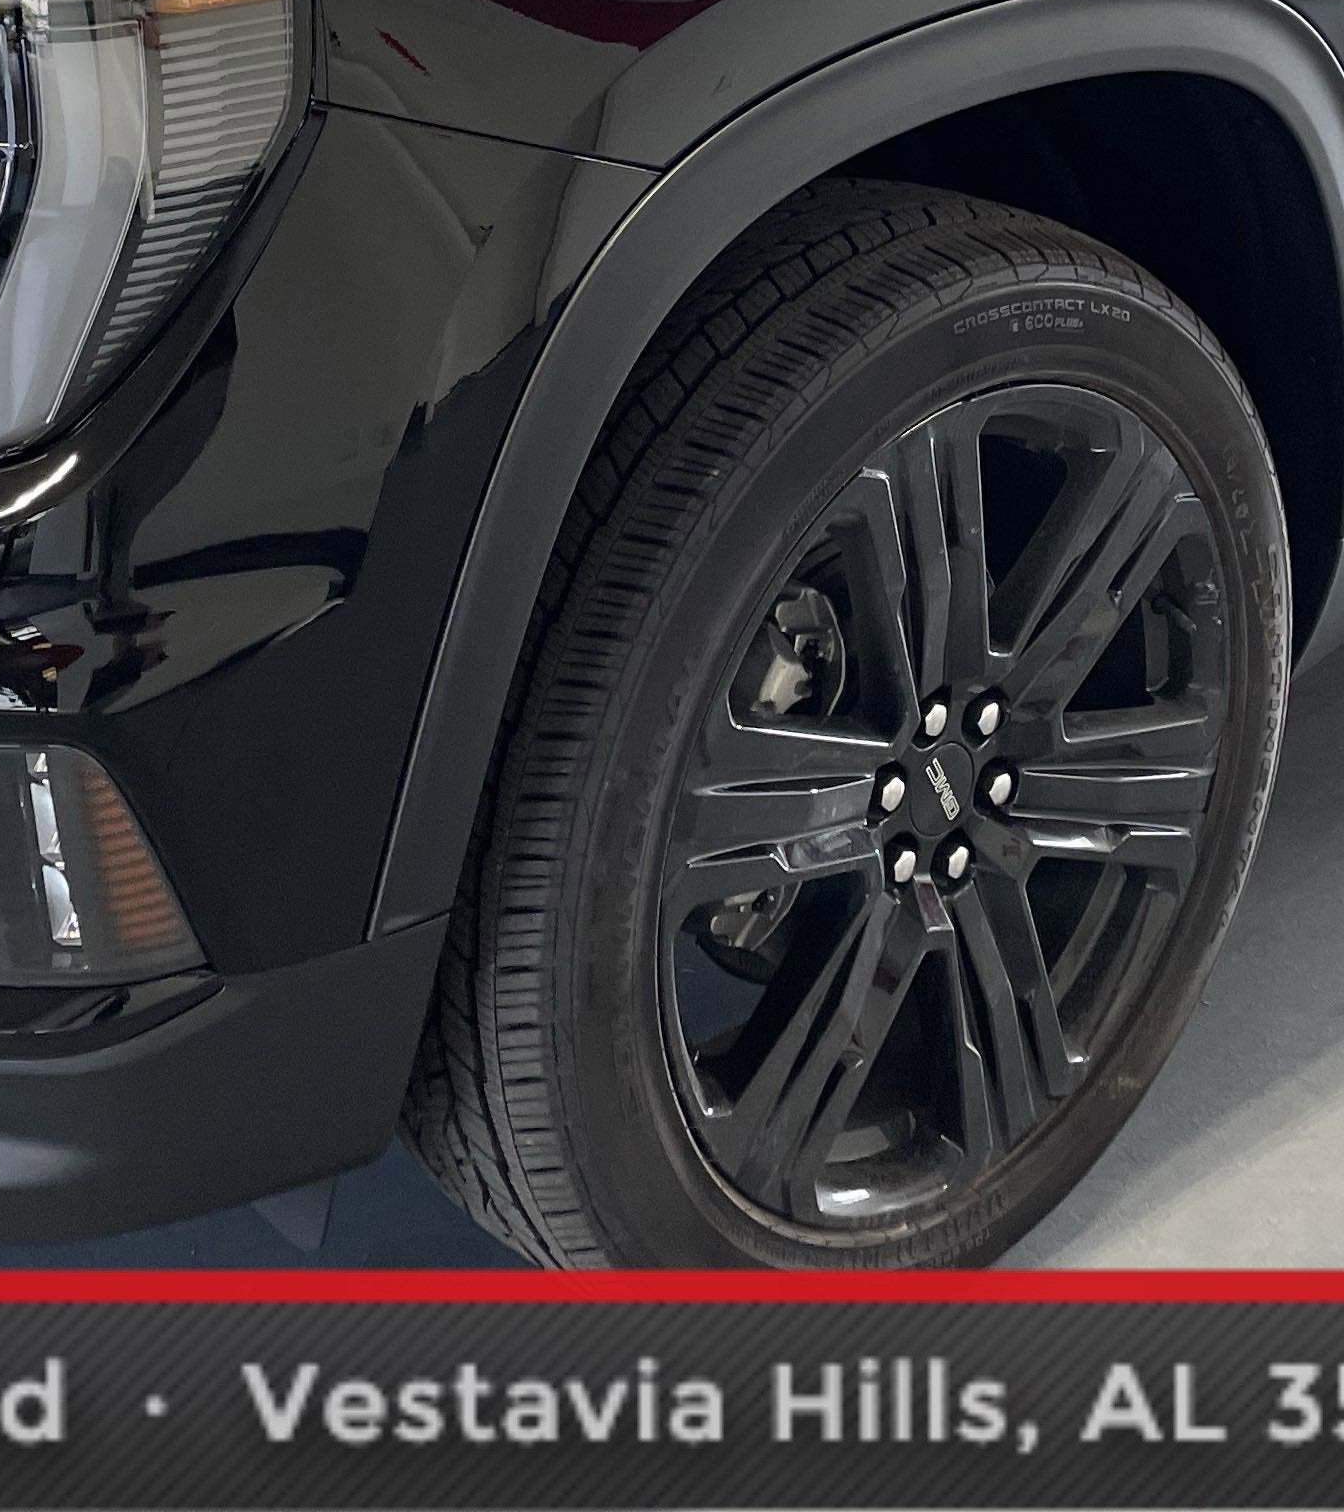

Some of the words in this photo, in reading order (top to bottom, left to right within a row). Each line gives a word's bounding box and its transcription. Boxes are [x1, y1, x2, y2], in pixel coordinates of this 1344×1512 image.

[953, 298, 1086, 335] CROSSCONTACT
[1090, 300, 1132, 324] LX20
[924, 757, 960, 821] GMC
